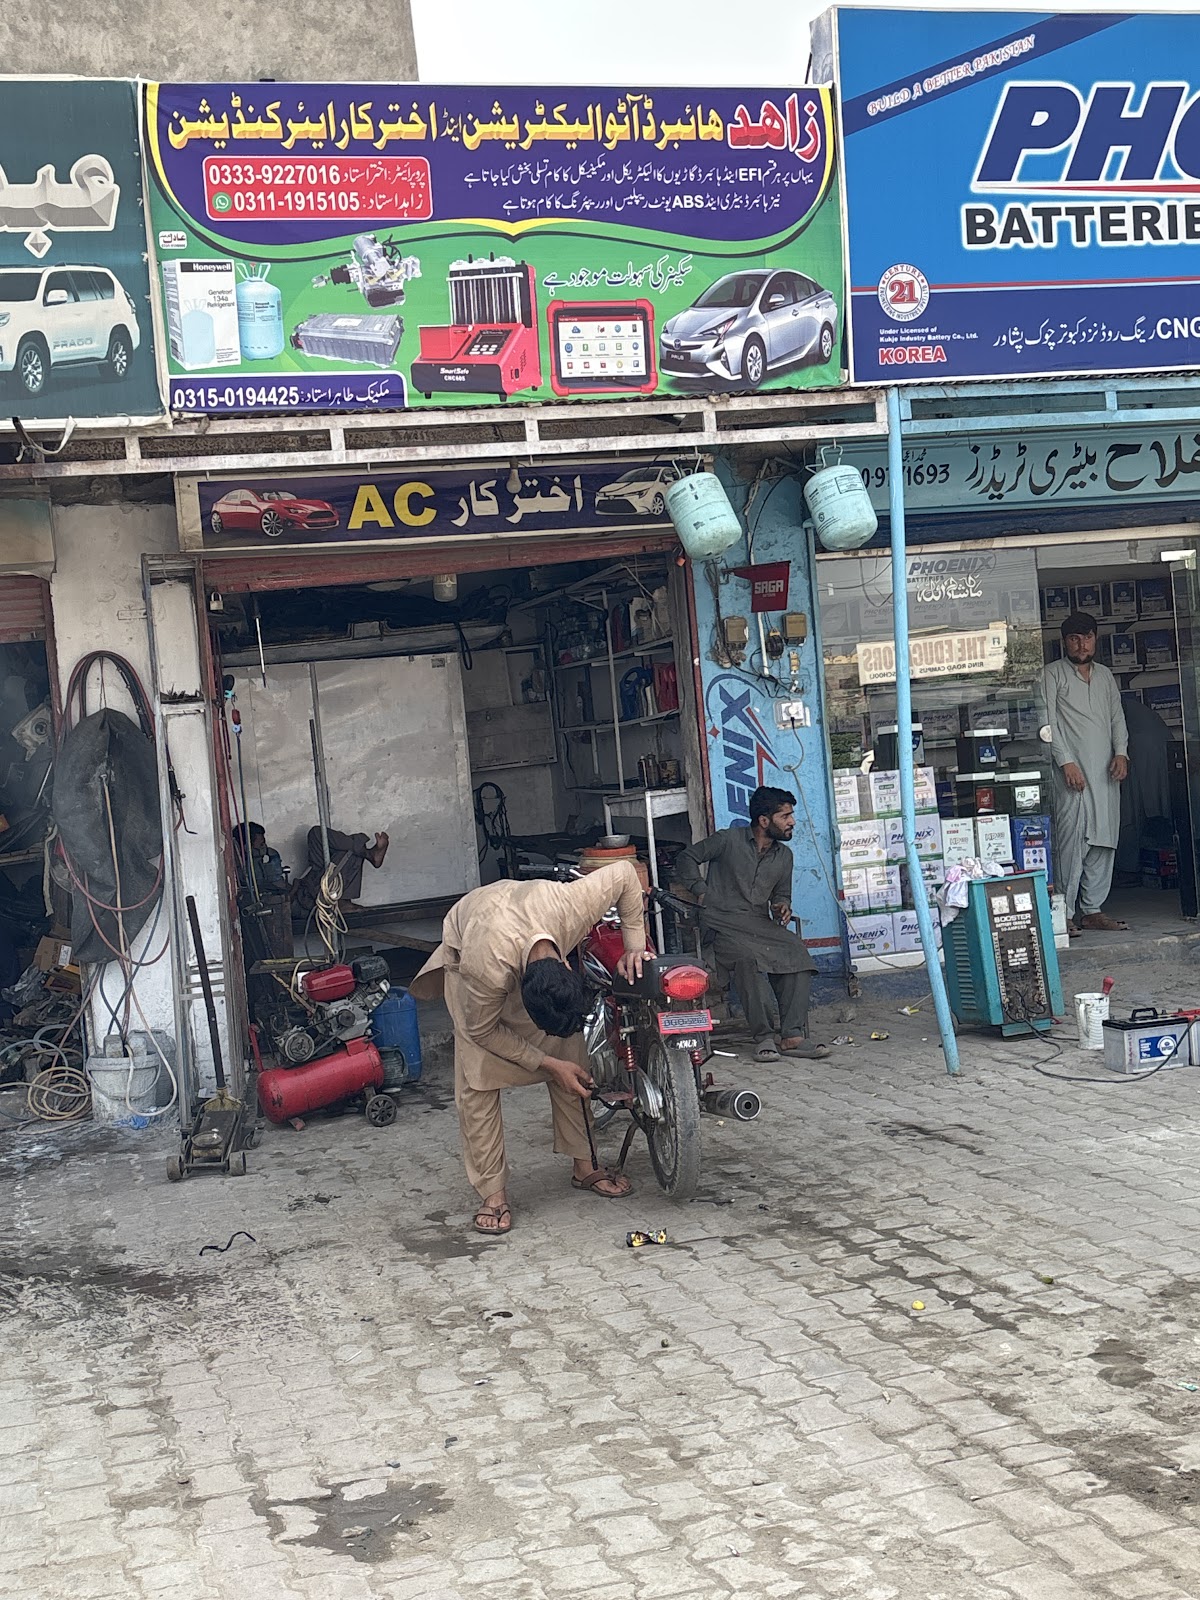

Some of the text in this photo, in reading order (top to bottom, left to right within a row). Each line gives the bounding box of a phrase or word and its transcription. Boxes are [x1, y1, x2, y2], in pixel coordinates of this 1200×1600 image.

[867, 34, 1036, 116] BUILD A BETTER PAKISTAN
[335, 101, 375, 150] کار
[373, 101, 438, 150] اختر
[974, 83, 1200, 184] PH
[209, 164, 341, 185] 0333-9227016
[739, 168, 762, 182] EFI
[234, 191, 360, 211] 0311-1915105
[672, 195, 704, 209] ABS
[192, 263, 231, 272] Honeywell
[884, 265, 923, 280] CENTURY
[889, 280, 919, 305] 21
[900, 335, 926, 343] Industry
[993, 326, 1024, 353] پشاور
[879, 345, 948, 365] KOREA
[174, 386, 300, 408] 0315-0194425
[347, 475, 584, 530] اختر کار AC
[909, 555, 994, 576] PHOENIX
[754, 579, 784, 594] SAGA
[994, 913, 1032, 923] BOOSTER
